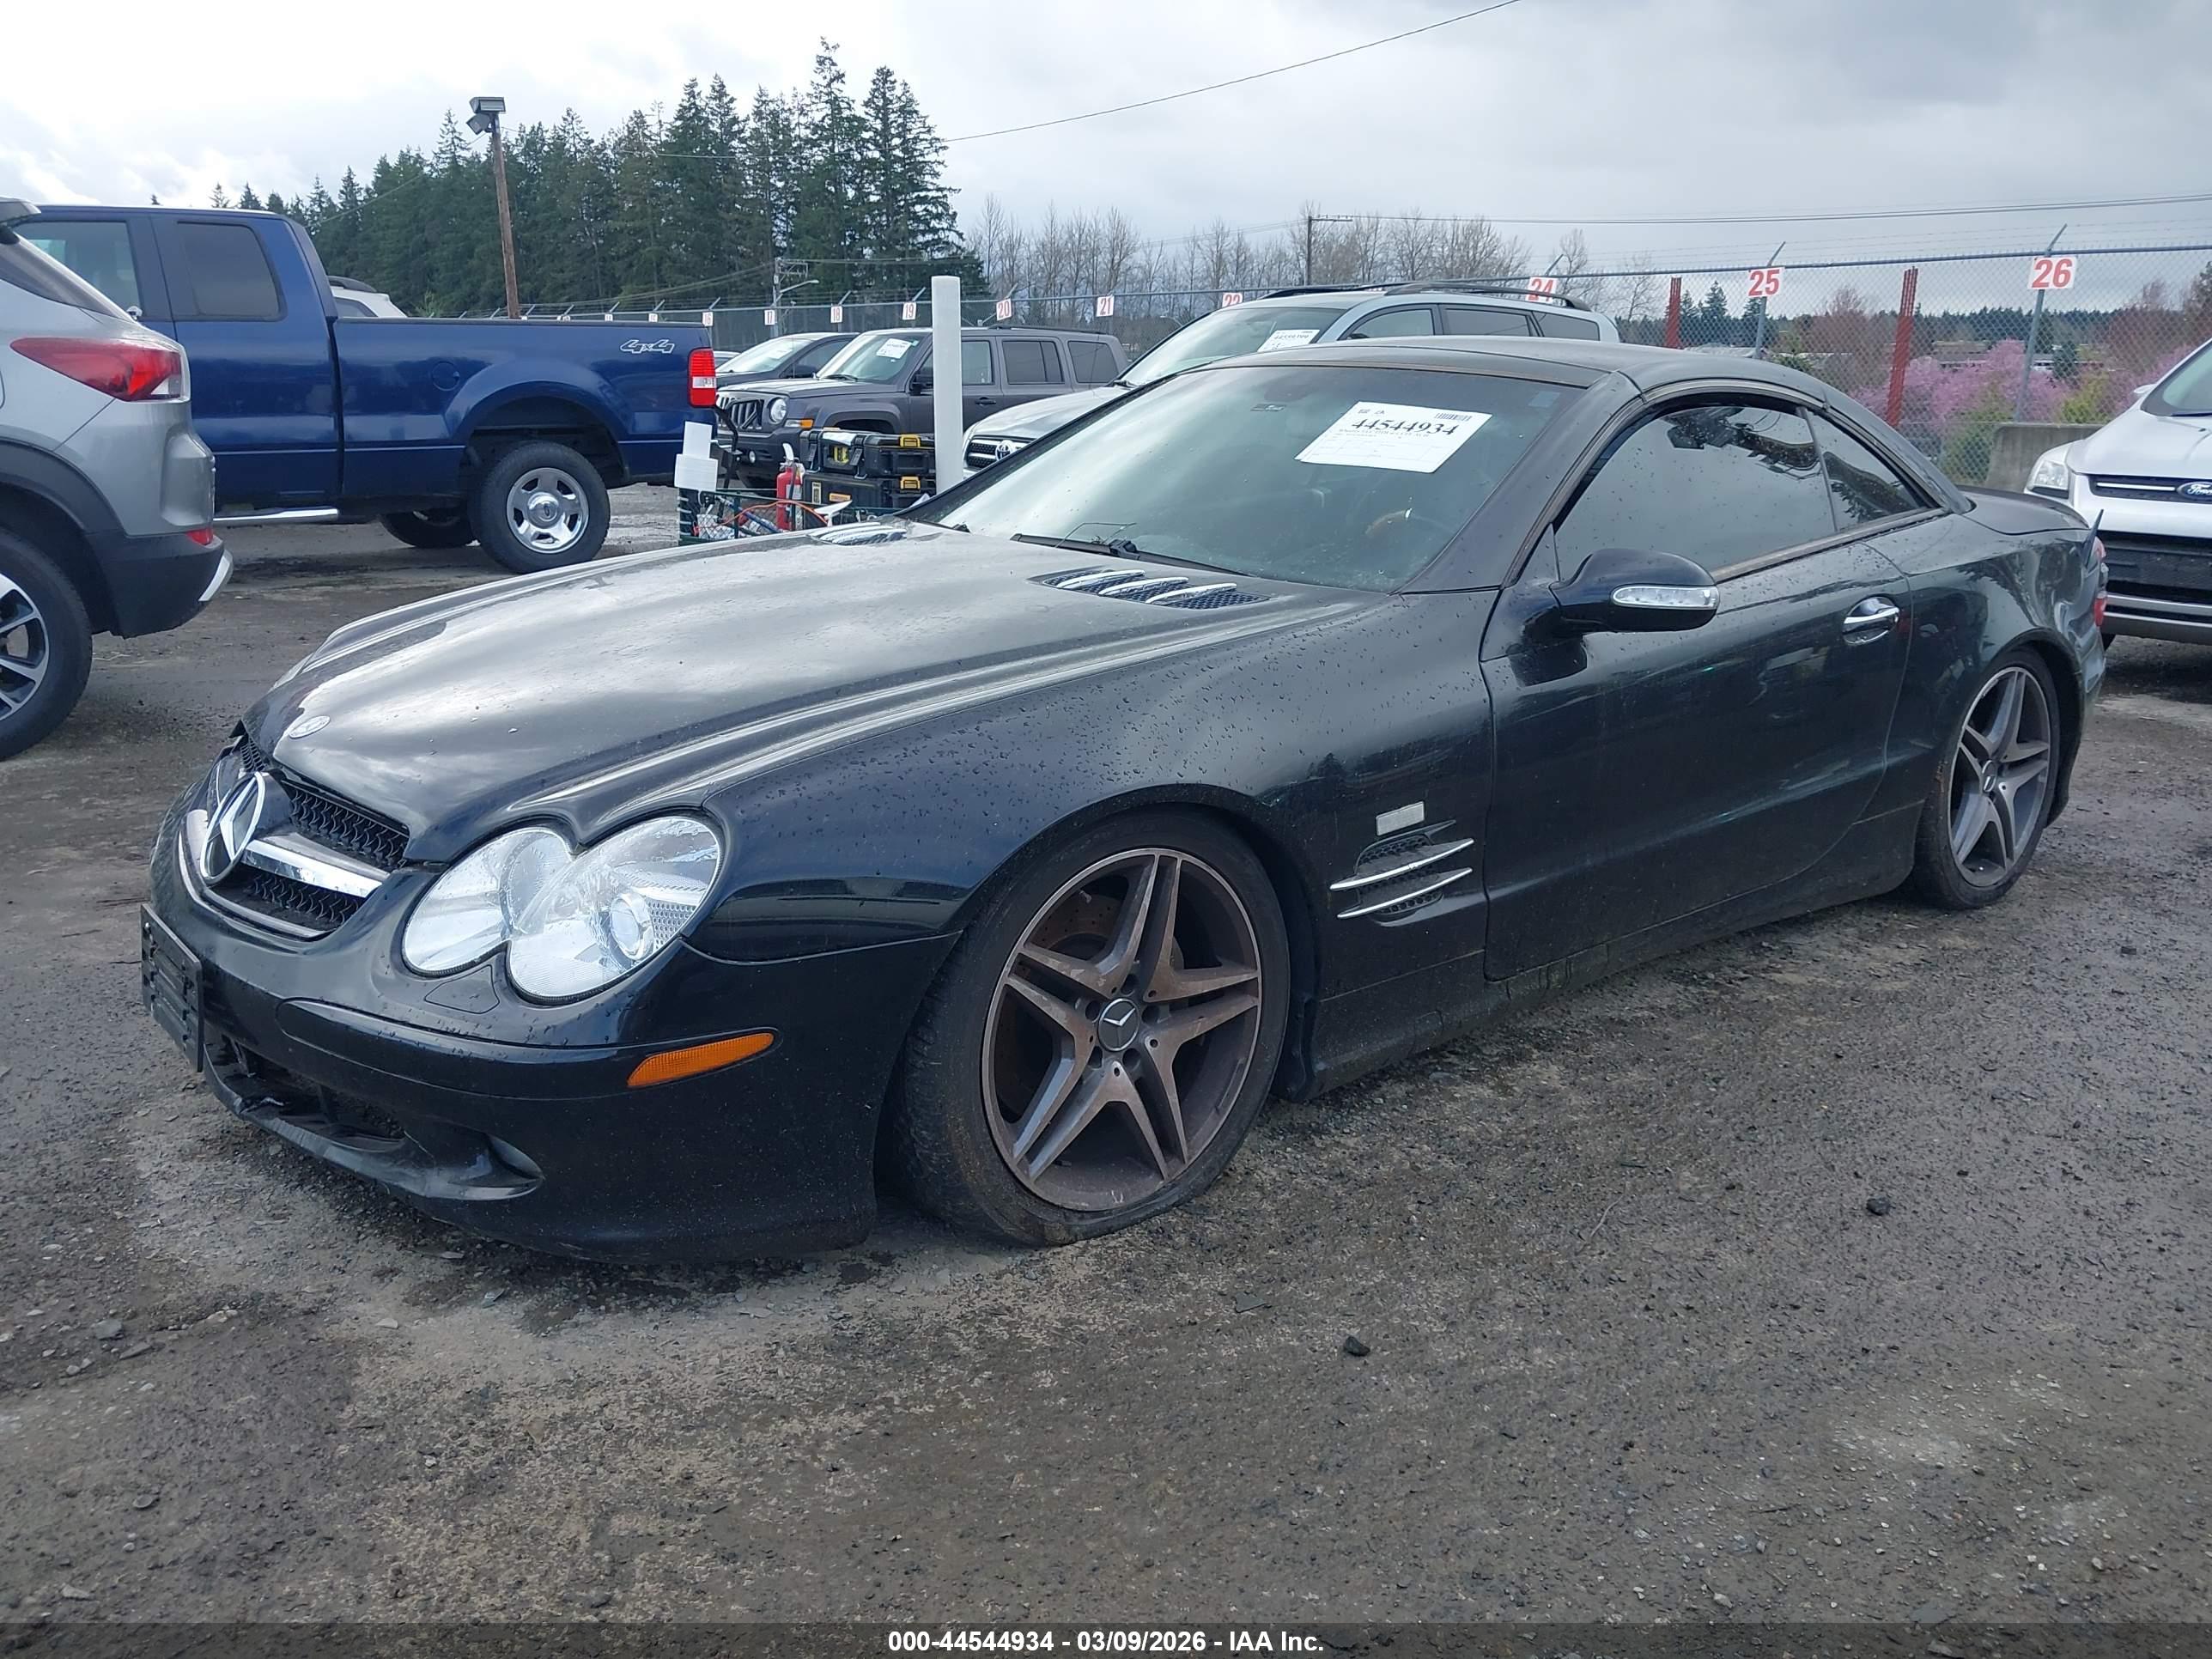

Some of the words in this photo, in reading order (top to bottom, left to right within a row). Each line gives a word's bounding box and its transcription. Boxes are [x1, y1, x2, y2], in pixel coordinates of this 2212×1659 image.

[2032, 258, 2072, 288] 26
[1528, 278, 1553, 301] 24
[1748, 270, 1779, 296] 25
[905, 303, 915, 319] 19
[998, 301, 1011, 319] 20
[1099, 297, 1111, 315] 21
[620, 339, 675, 354] 4x4
[1352, 419, 1459, 435] 44544934
